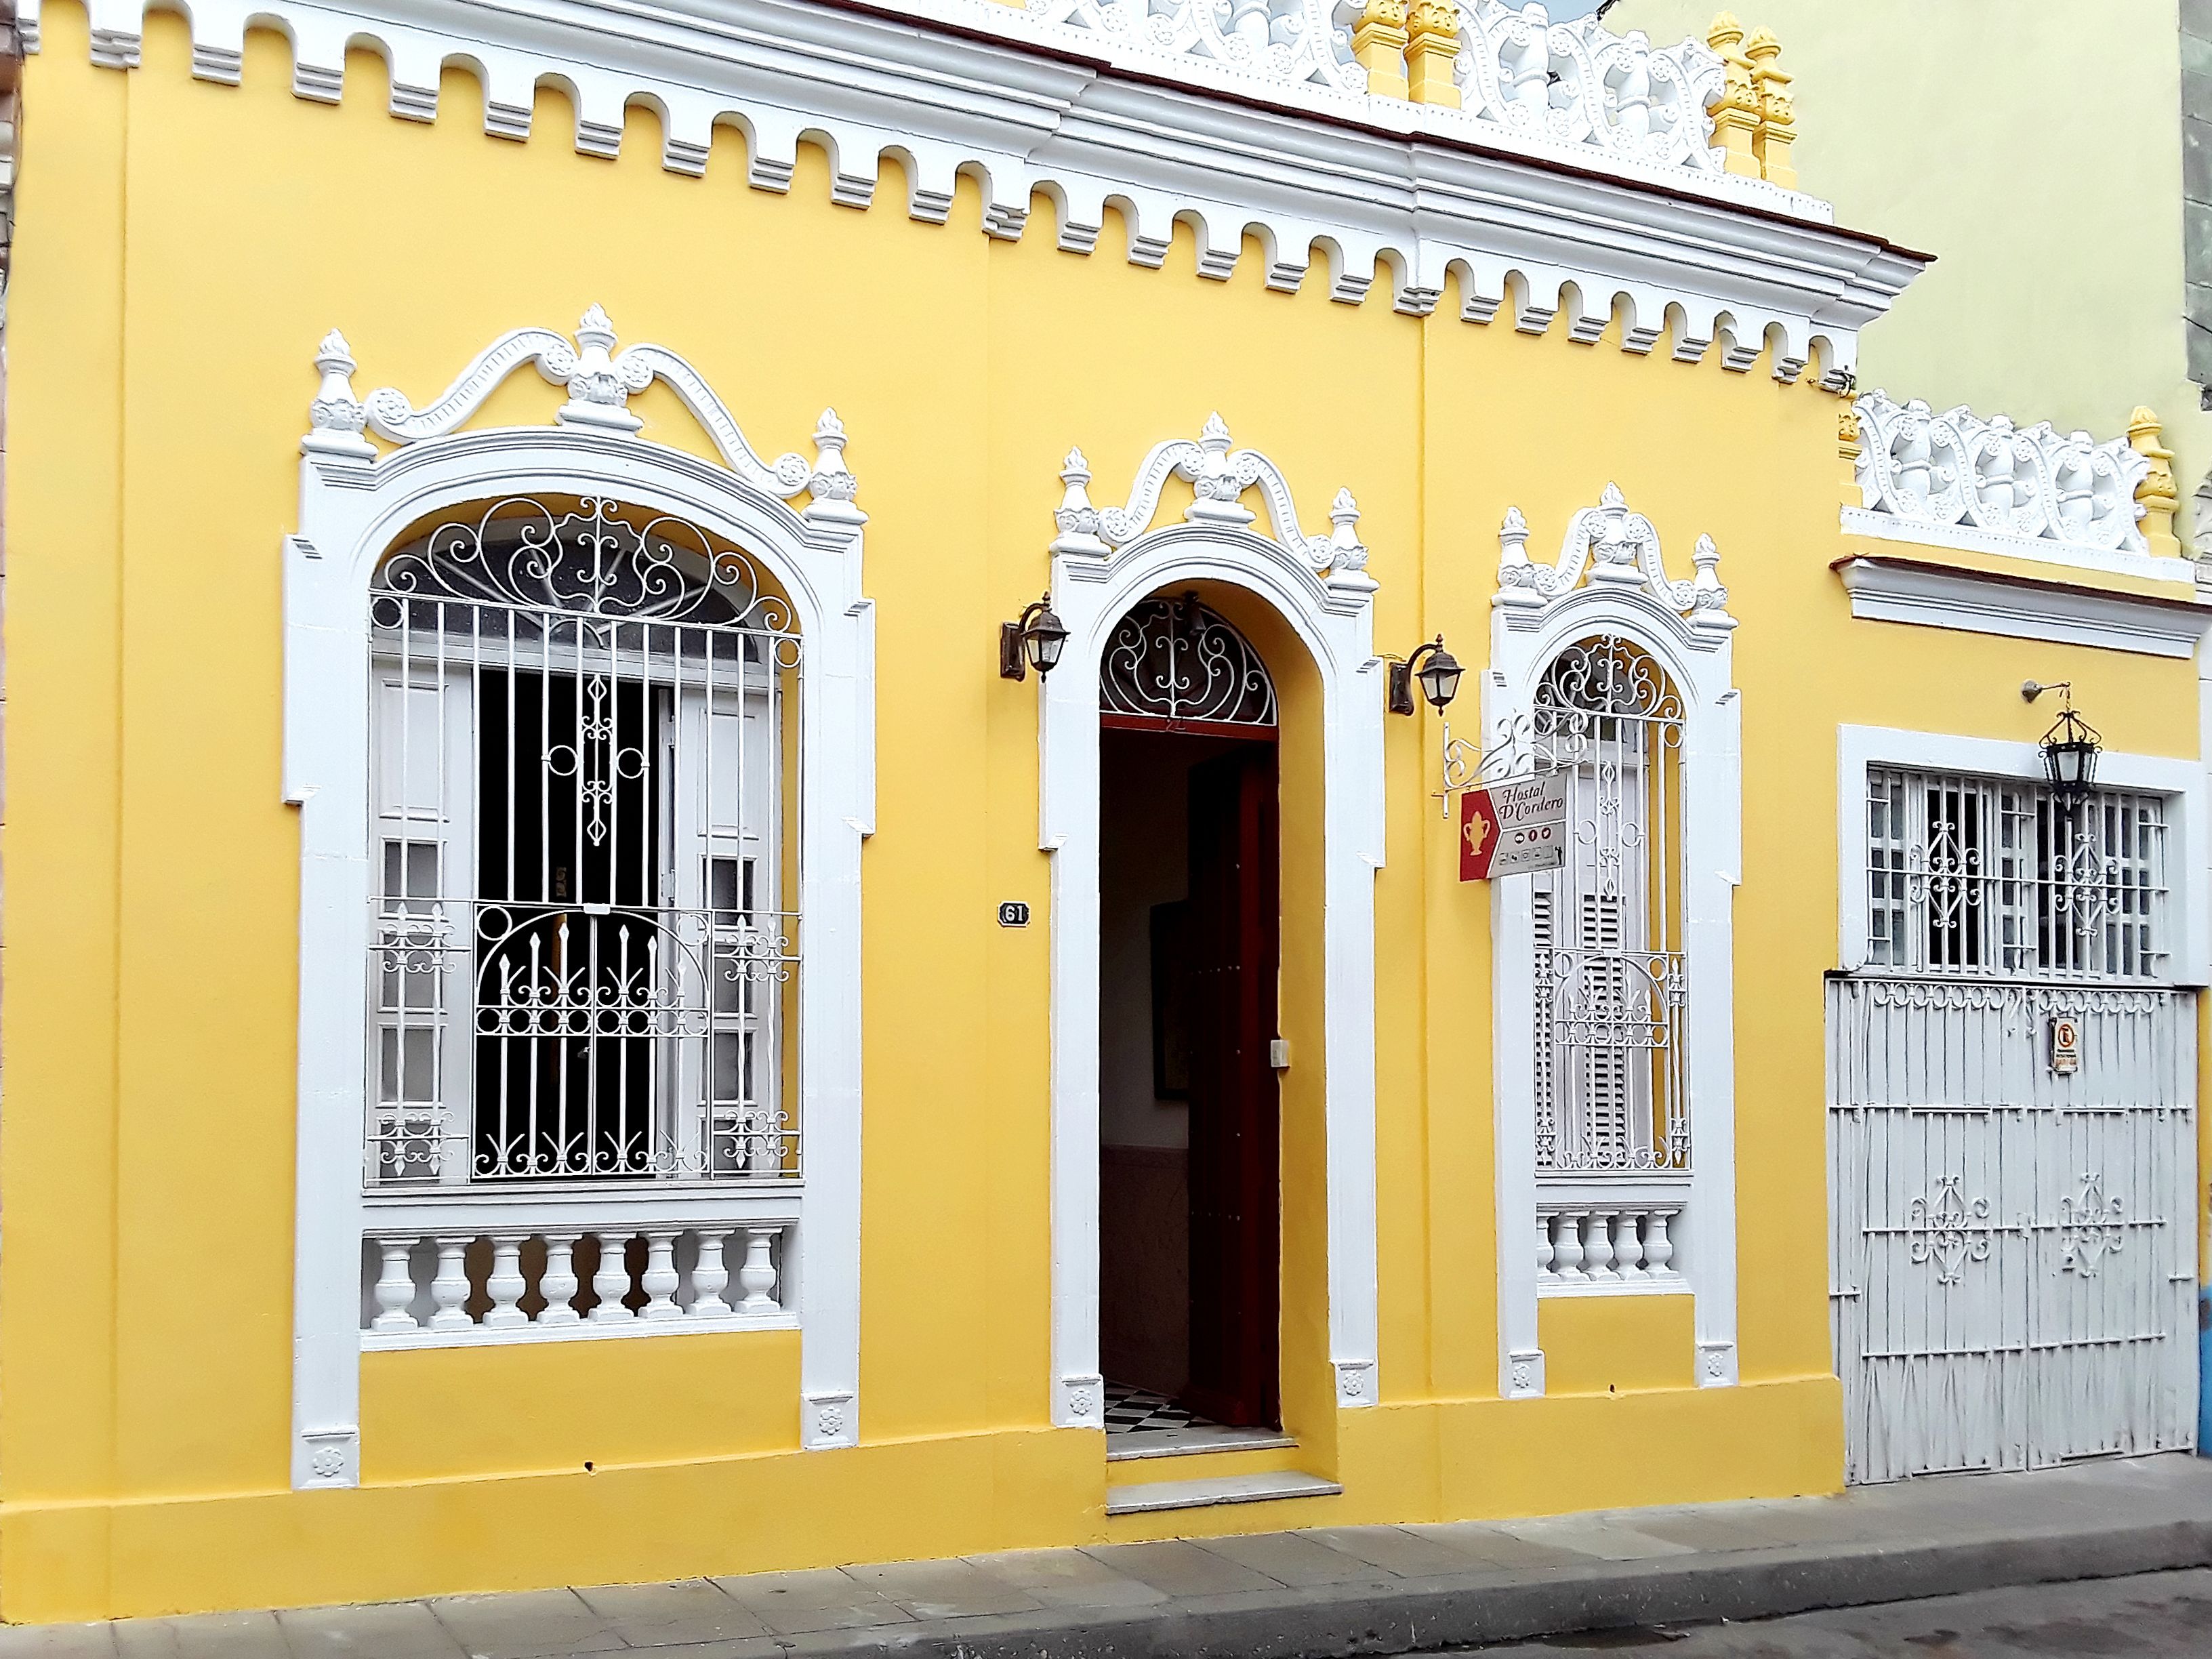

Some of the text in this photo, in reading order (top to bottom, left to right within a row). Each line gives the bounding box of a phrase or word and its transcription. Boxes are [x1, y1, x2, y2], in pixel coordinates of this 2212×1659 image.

[1502, 781, 1545, 804] Hostal
[1499, 796, 1563, 821] D'Cordero
[1005, 905, 1023, 922] 61
